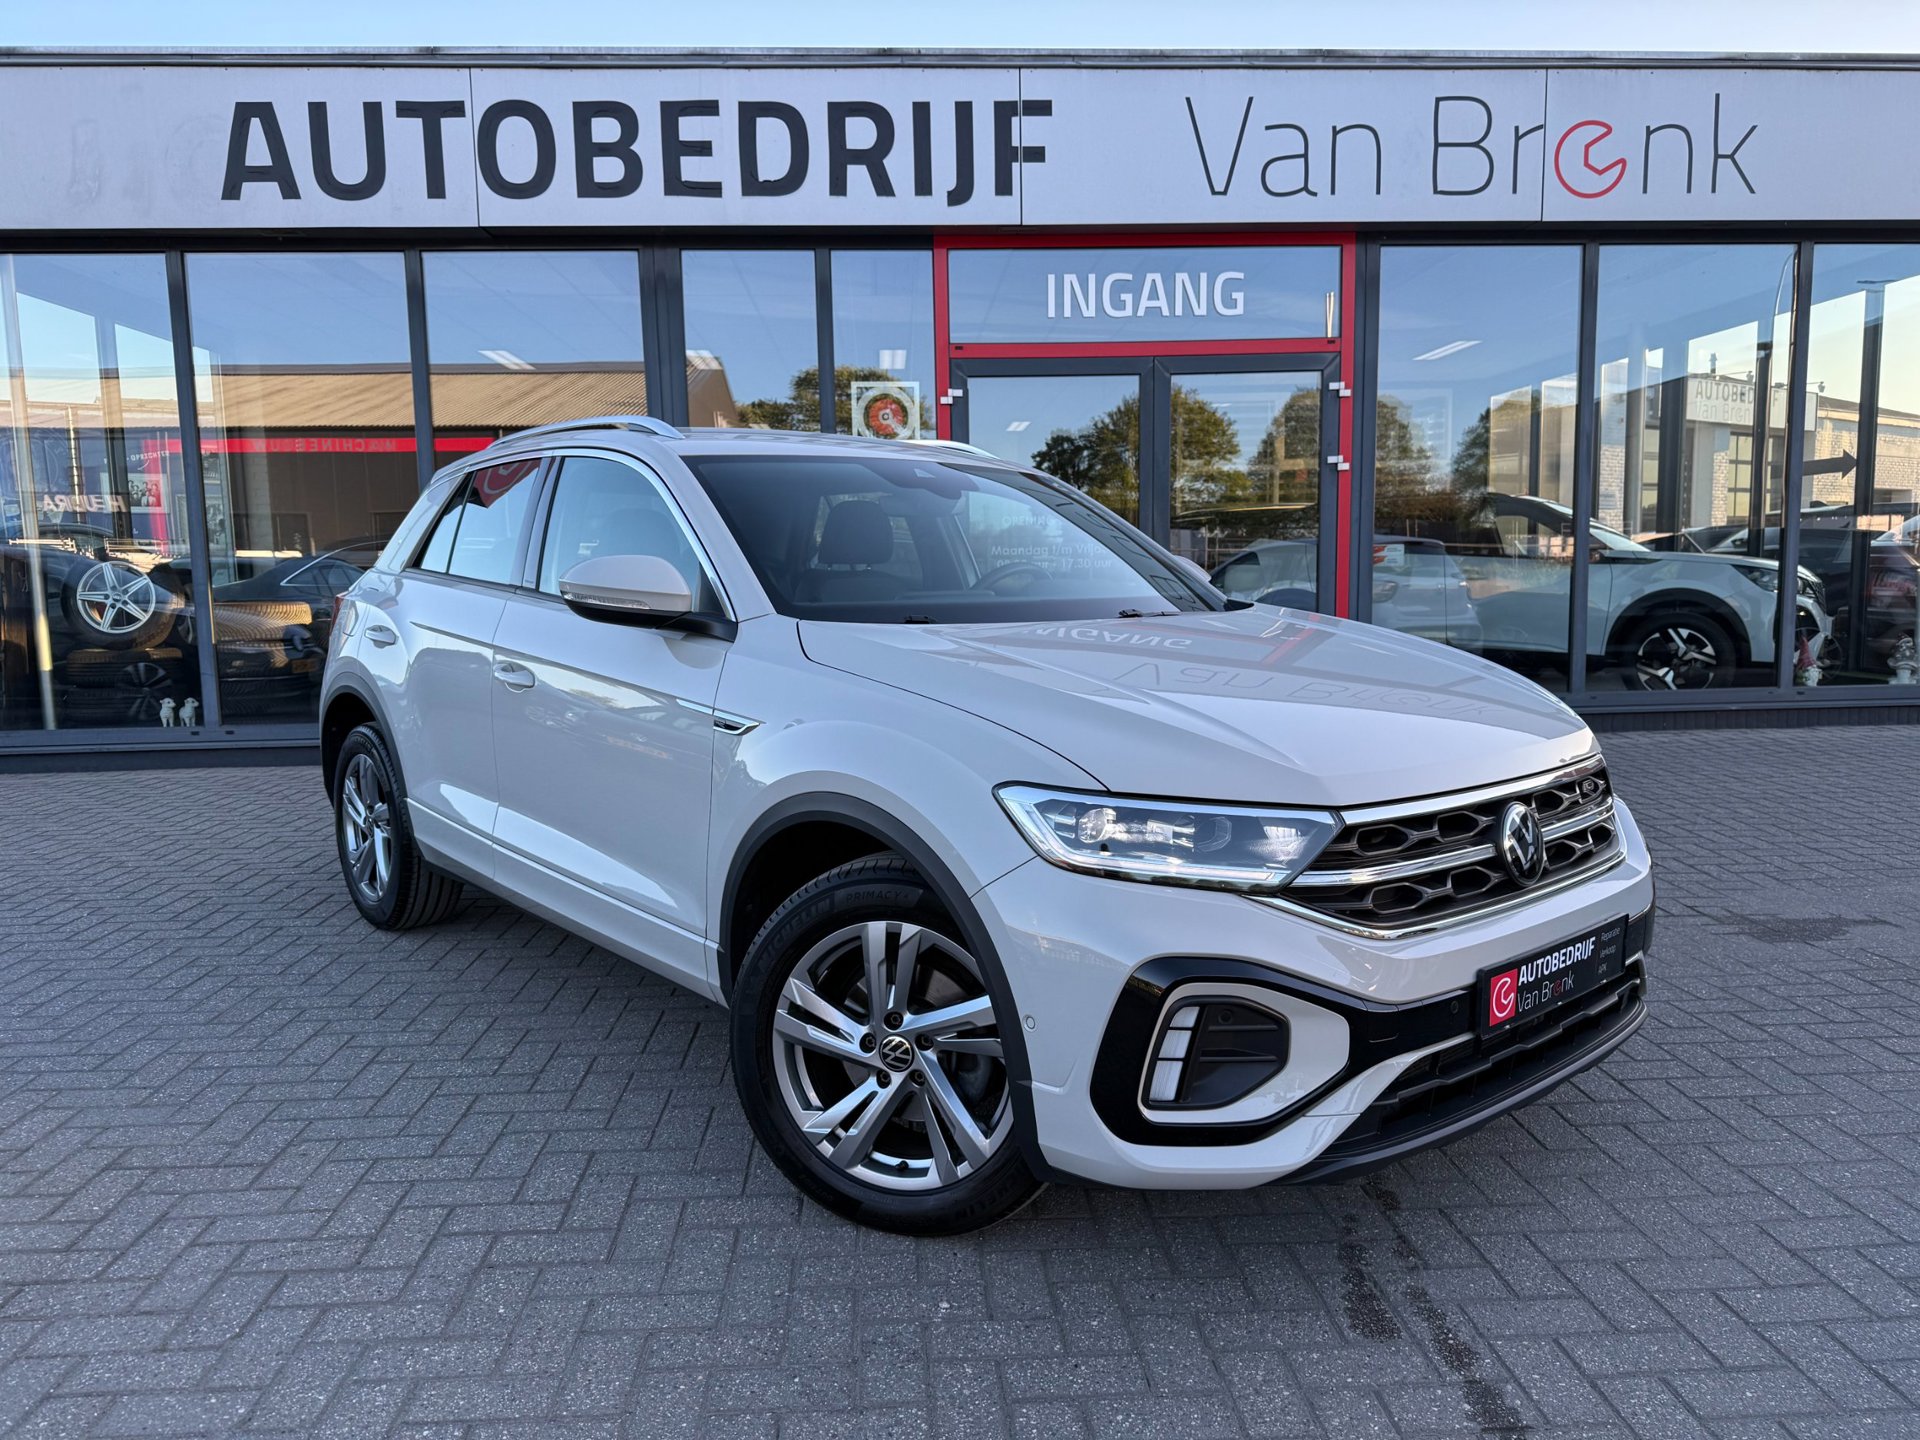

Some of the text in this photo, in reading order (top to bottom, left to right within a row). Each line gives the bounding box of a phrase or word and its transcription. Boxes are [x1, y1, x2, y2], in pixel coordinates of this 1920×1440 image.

[221, 99, 1052, 206] AUTOBEDRIJF
[1186, 96, 1383, 198] Van
[1047, 271, 1246, 319] INGANG
[991, 546, 1049, 559] Maandag
[846, 889, 902, 905] PRIMACY
[757, 897, 832, 974] MICHELIN
[1518, 936, 1596, 986] AUTOBEDRIJF
[1517, 989, 1539, 1012] Van
